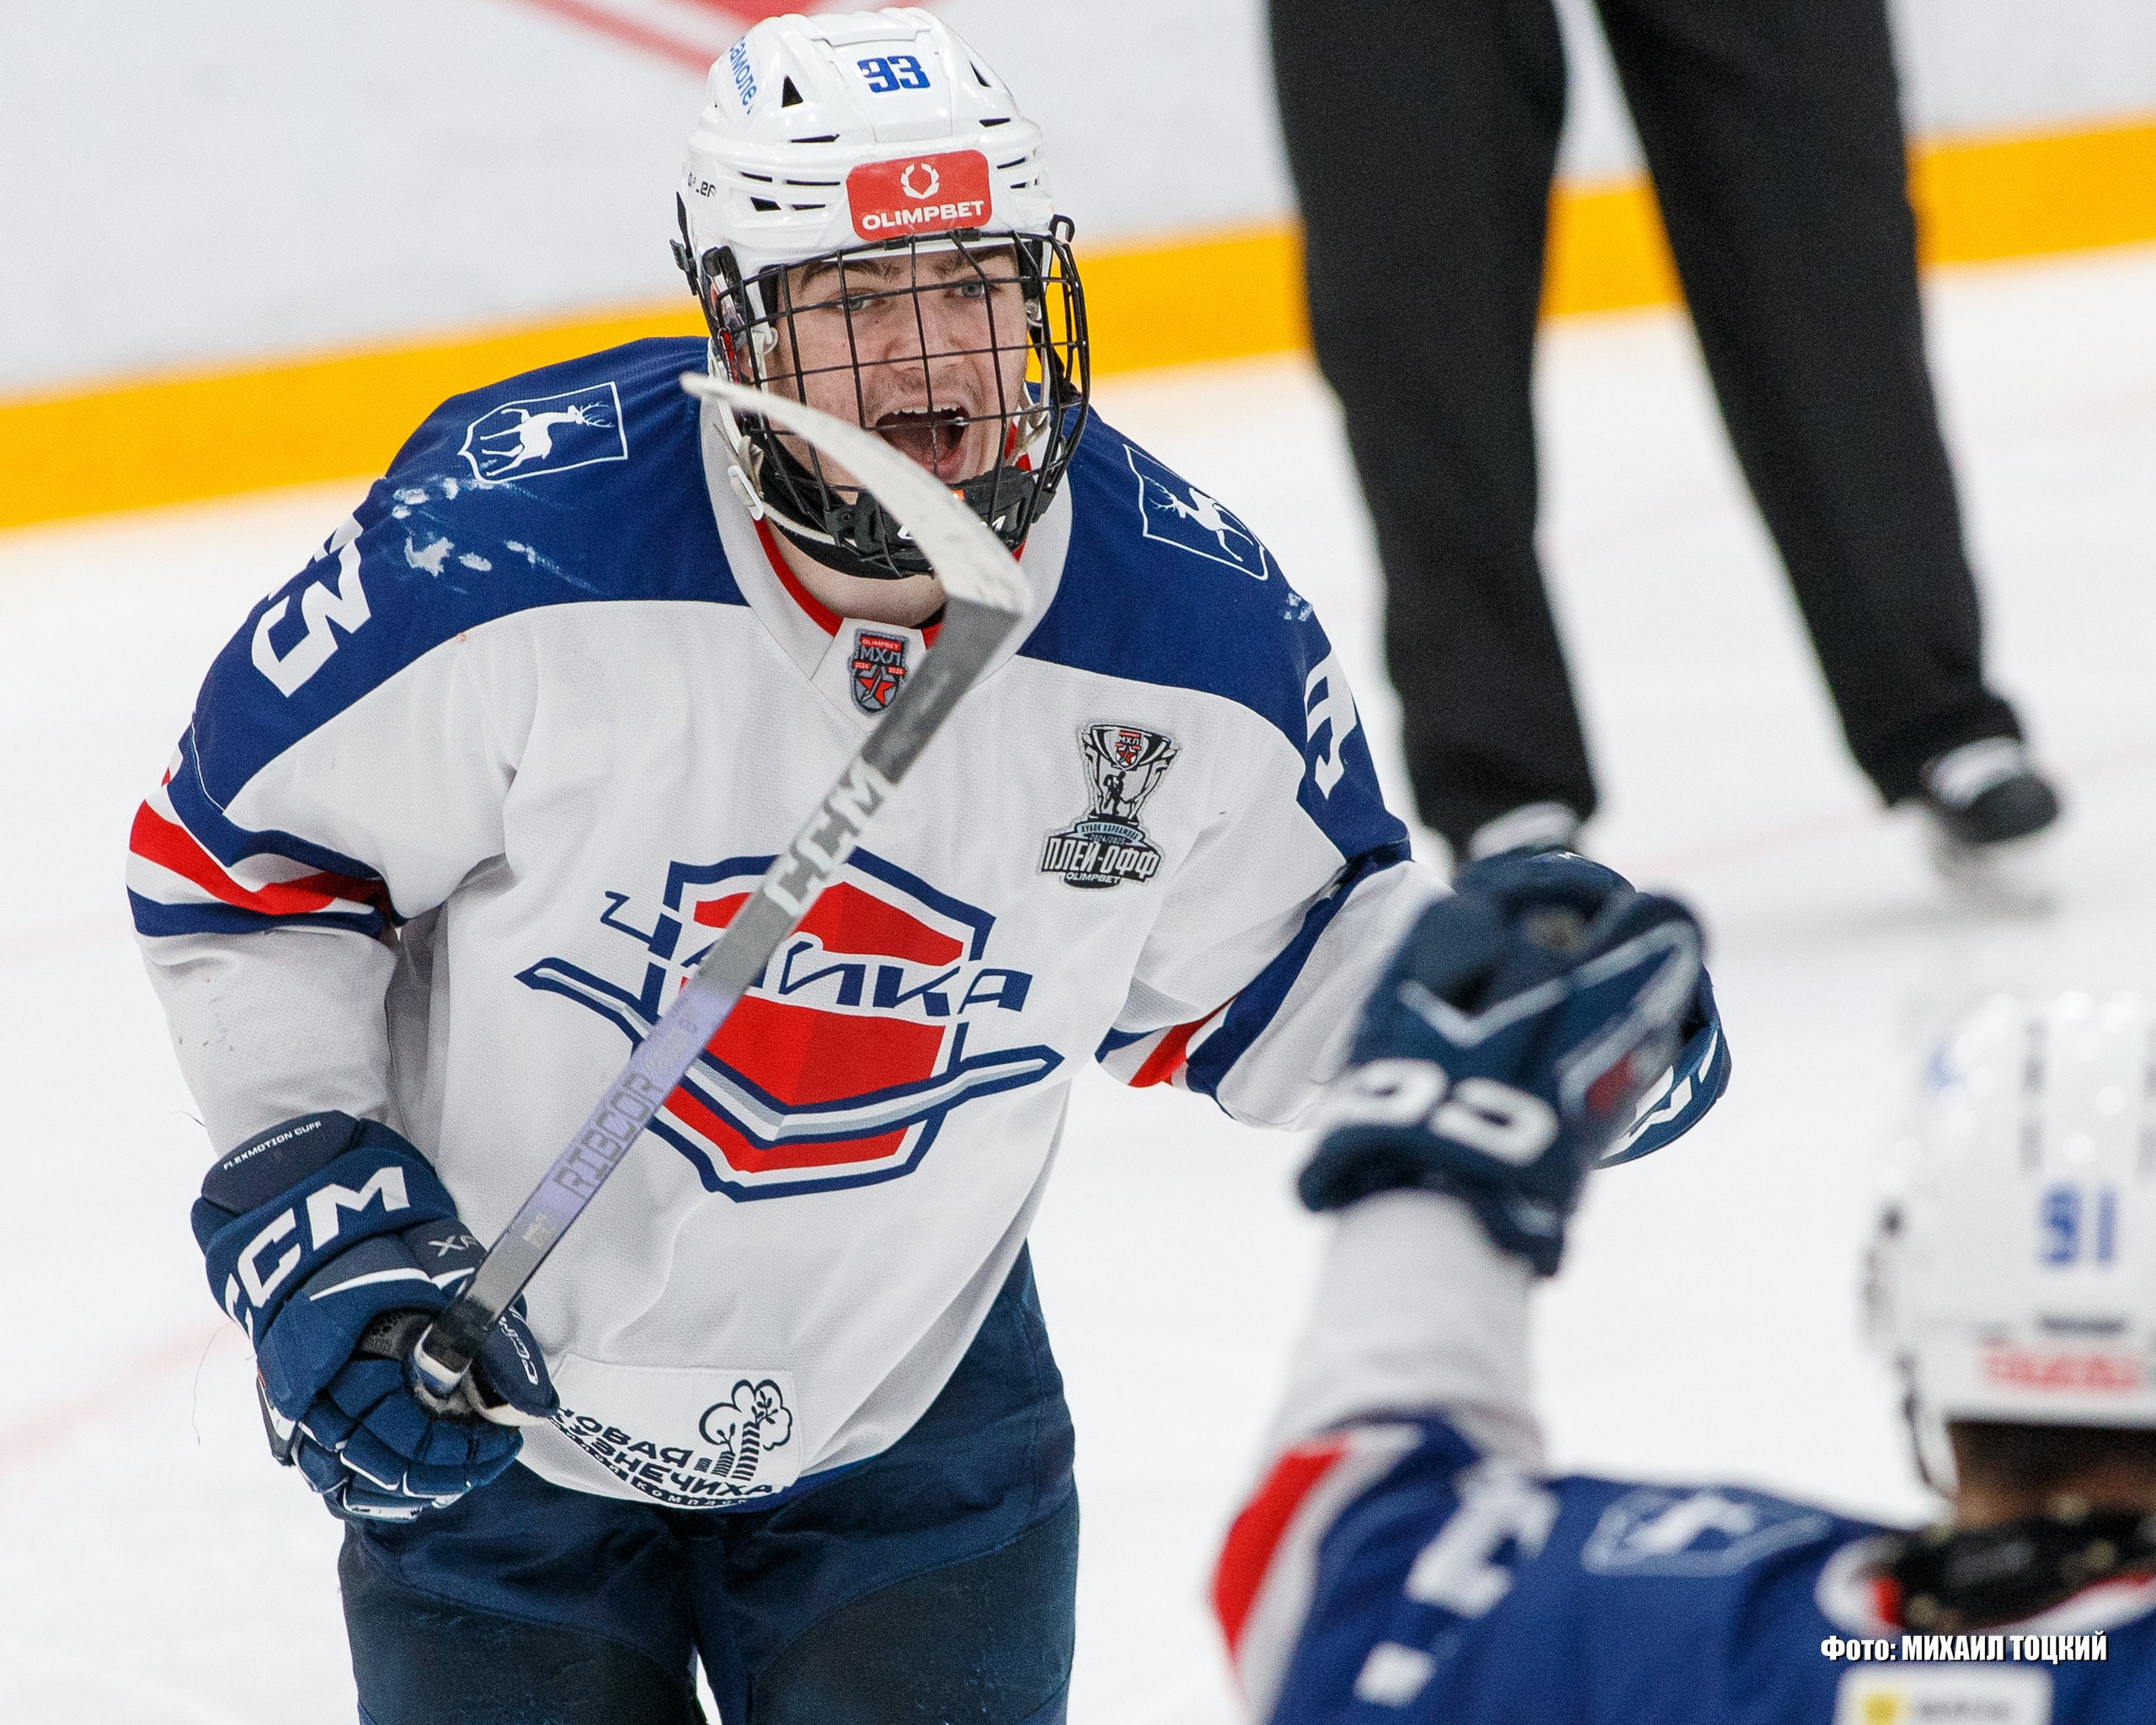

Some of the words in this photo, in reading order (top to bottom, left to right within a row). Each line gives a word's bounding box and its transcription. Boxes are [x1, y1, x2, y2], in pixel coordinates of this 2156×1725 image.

[857, 55, 931, 93] 93
[862, 200, 985, 231] OLIMPBET
[862, 638, 899, 650] OLIMPBET
[763, 758, 891, 917] CCM
[1065, 872, 1122, 884] OLIMPBET
[222, 1130, 294, 1171] FLEXMOTION
[293, 1119, 323, 1136] CUFF
